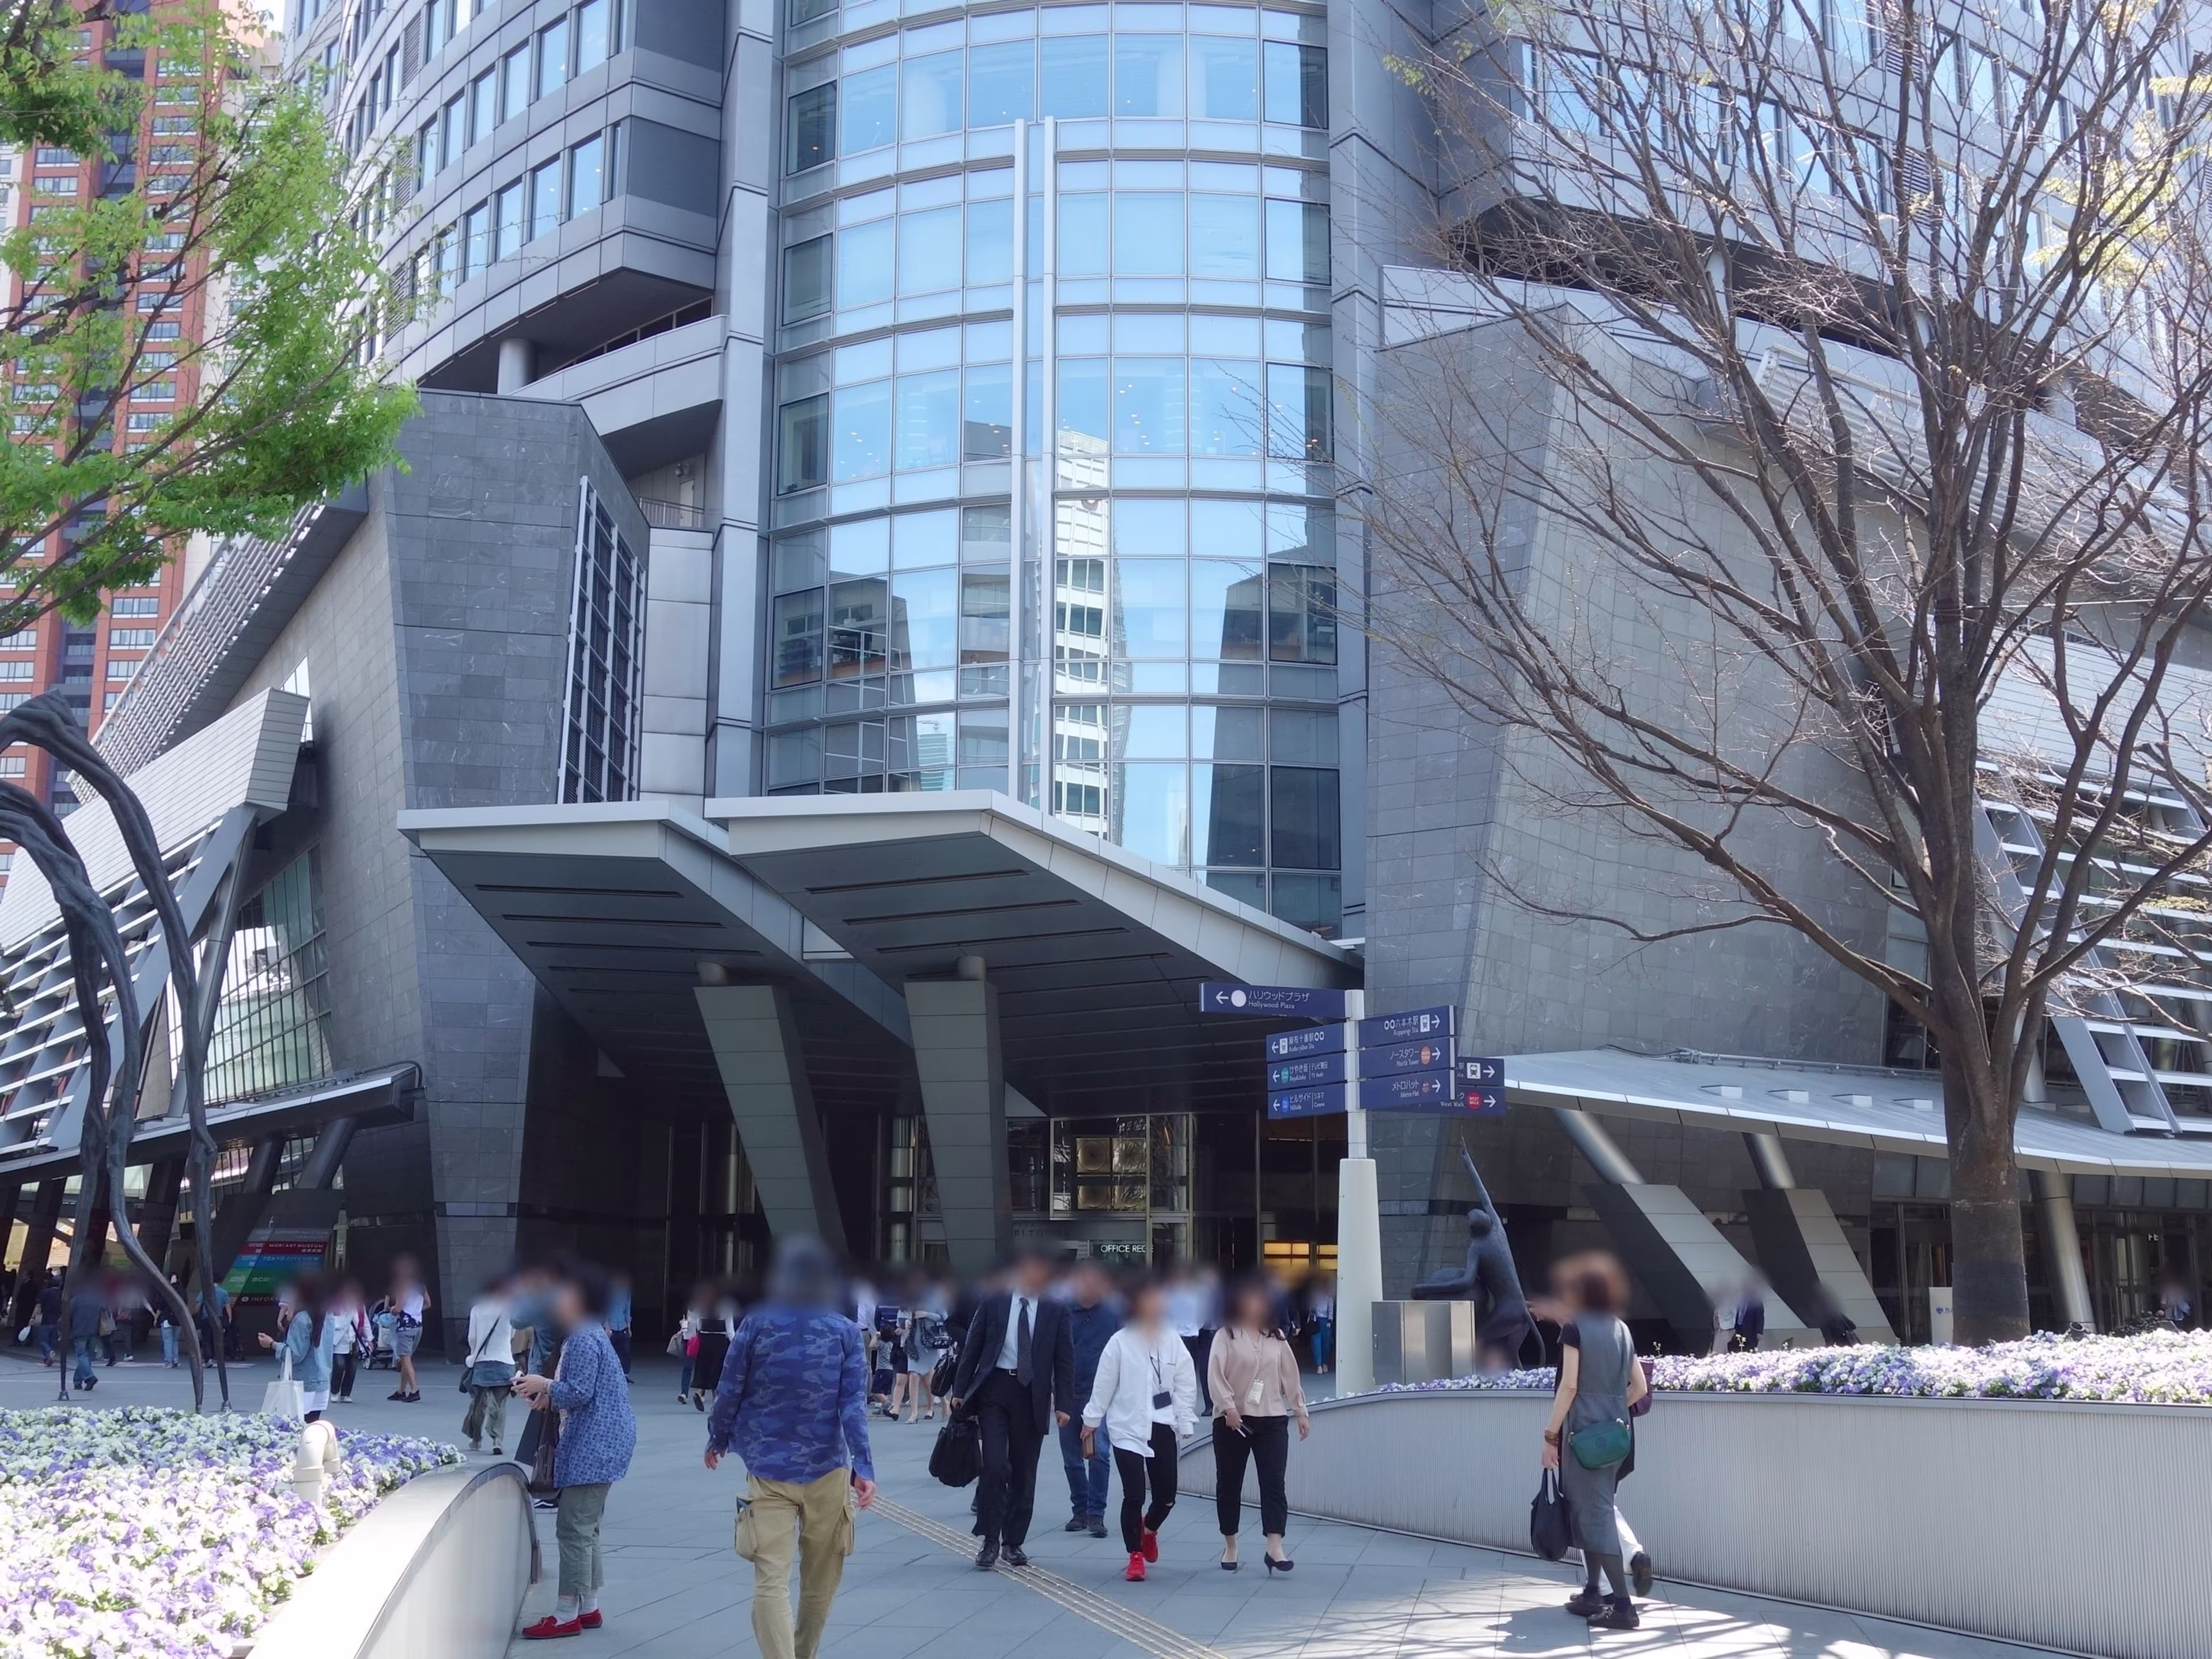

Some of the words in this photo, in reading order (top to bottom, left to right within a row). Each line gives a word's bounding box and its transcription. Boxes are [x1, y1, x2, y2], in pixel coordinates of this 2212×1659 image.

[1249, 990, 1310, 1002] ハリウッドプラザ
[1248, 1000, 1279, 1009] Hollywood
[1389, 1048, 1419, 1060] ノースタワー
[1101, 1245, 1130, 1253] OFFICE
